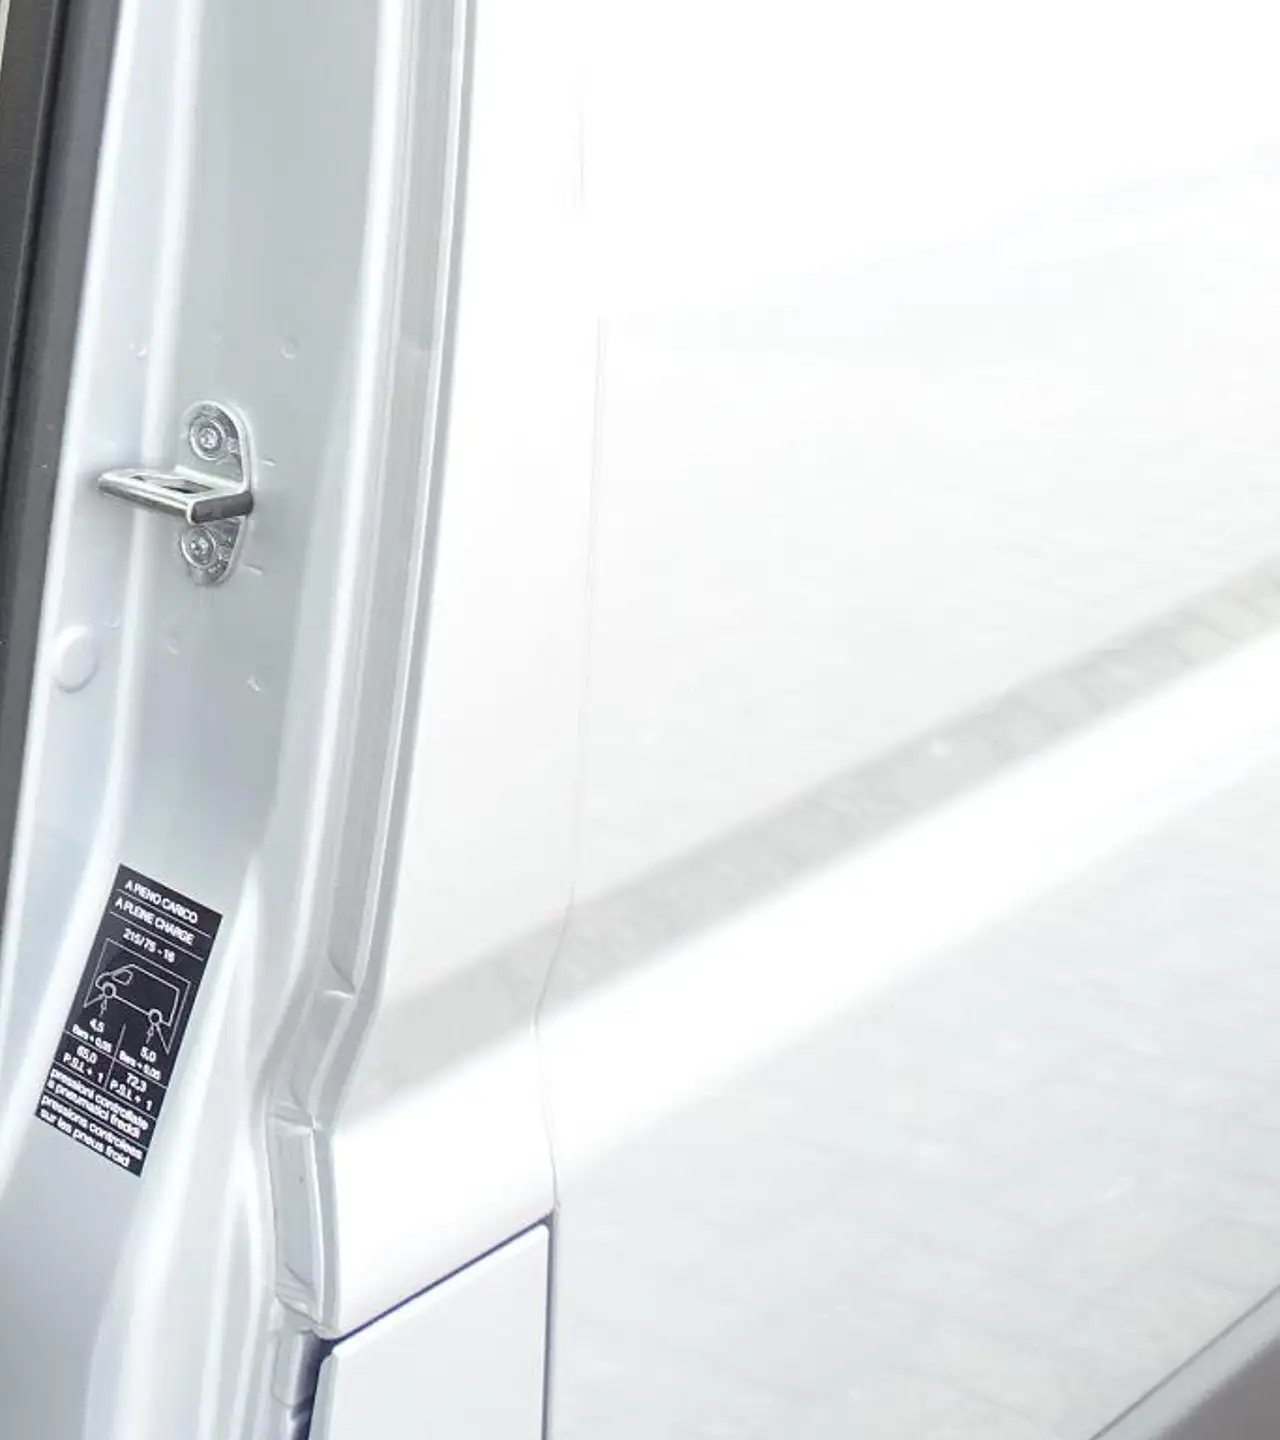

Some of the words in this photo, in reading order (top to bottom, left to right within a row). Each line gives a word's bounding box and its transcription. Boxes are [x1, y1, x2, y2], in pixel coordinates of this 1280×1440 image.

[125, 880, 132, 891] A
[162, 898, 197, 923] CARICO
[115, 897, 123, 909] A
[123, 900, 155, 924] PLEINE
[155, 917, 195, 945] CHARGE
[89, 1018, 105, 1033] 4.5
[140, 1046, 156, 1062] 5.0
[41, 1095, 88, 1128] pressions
[50, 1068, 95, 1099] pressioni
[95, 1094, 148, 1131] controllate
[57, 1117, 72, 1133] les
[72, 1128, 104, 1152] pneus
